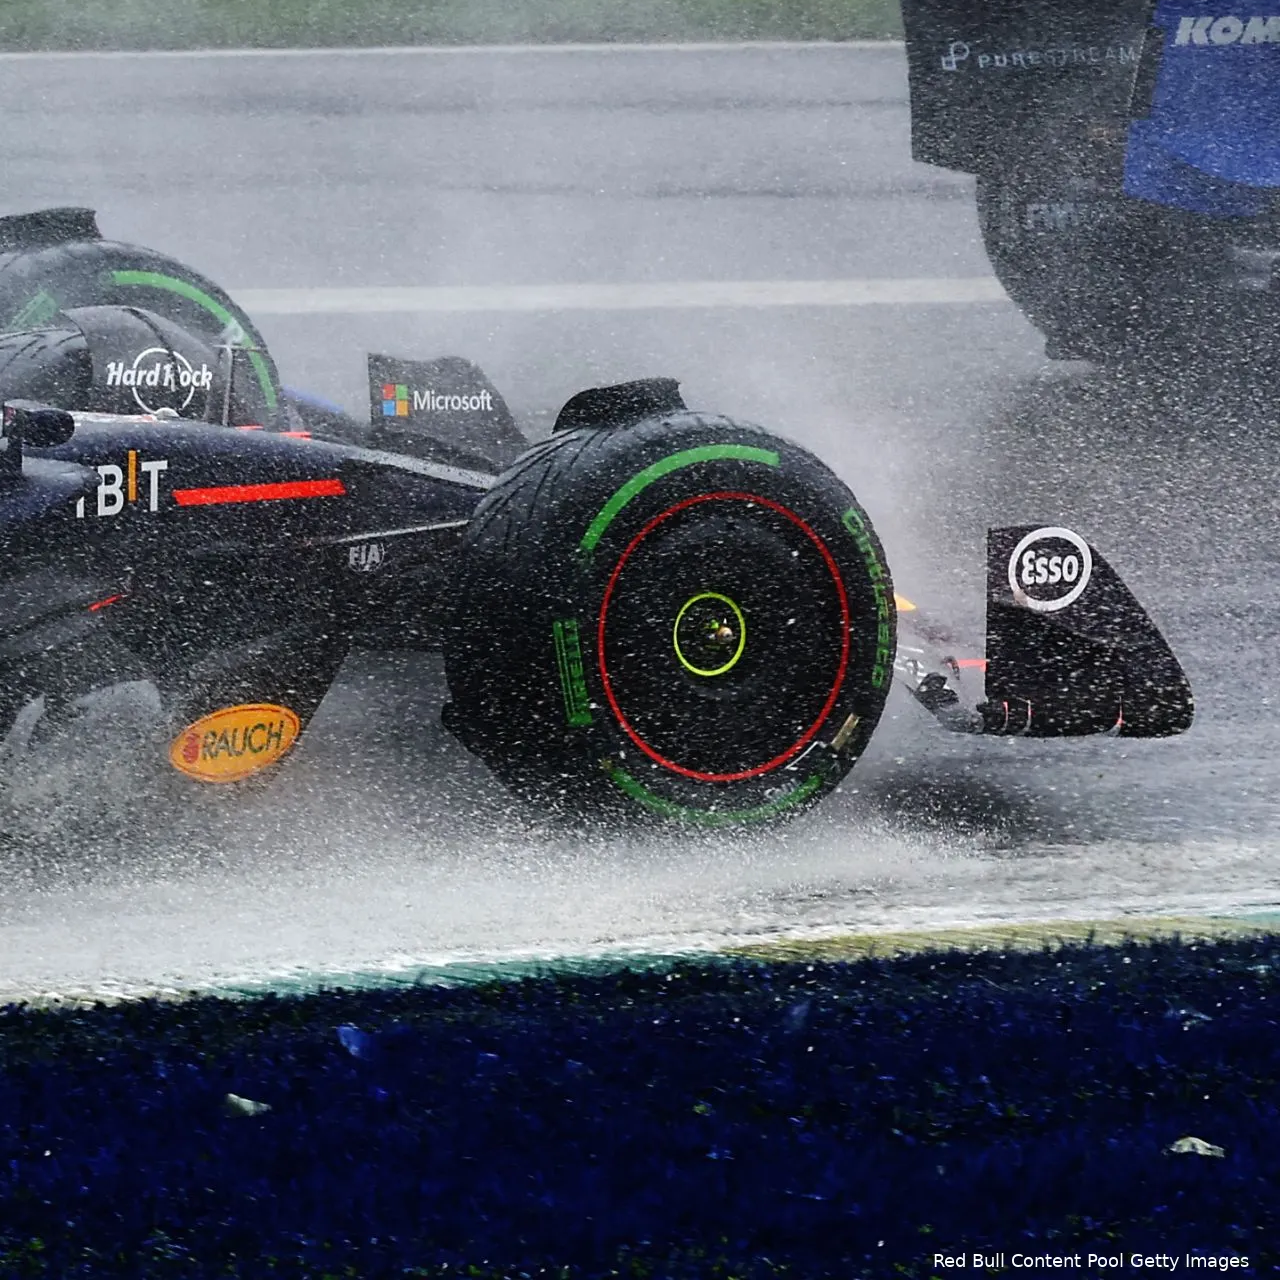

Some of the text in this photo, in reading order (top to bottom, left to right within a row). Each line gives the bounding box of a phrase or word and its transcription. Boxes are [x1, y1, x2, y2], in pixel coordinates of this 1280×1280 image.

[106, 361, 161, 387] Hard
[412, 388, 494, 413] Microsoft
[76, 449, 169, 519] BIT
[349, 545, 382, 564] FIA
[201, 720, 285, 761] RAUCH
